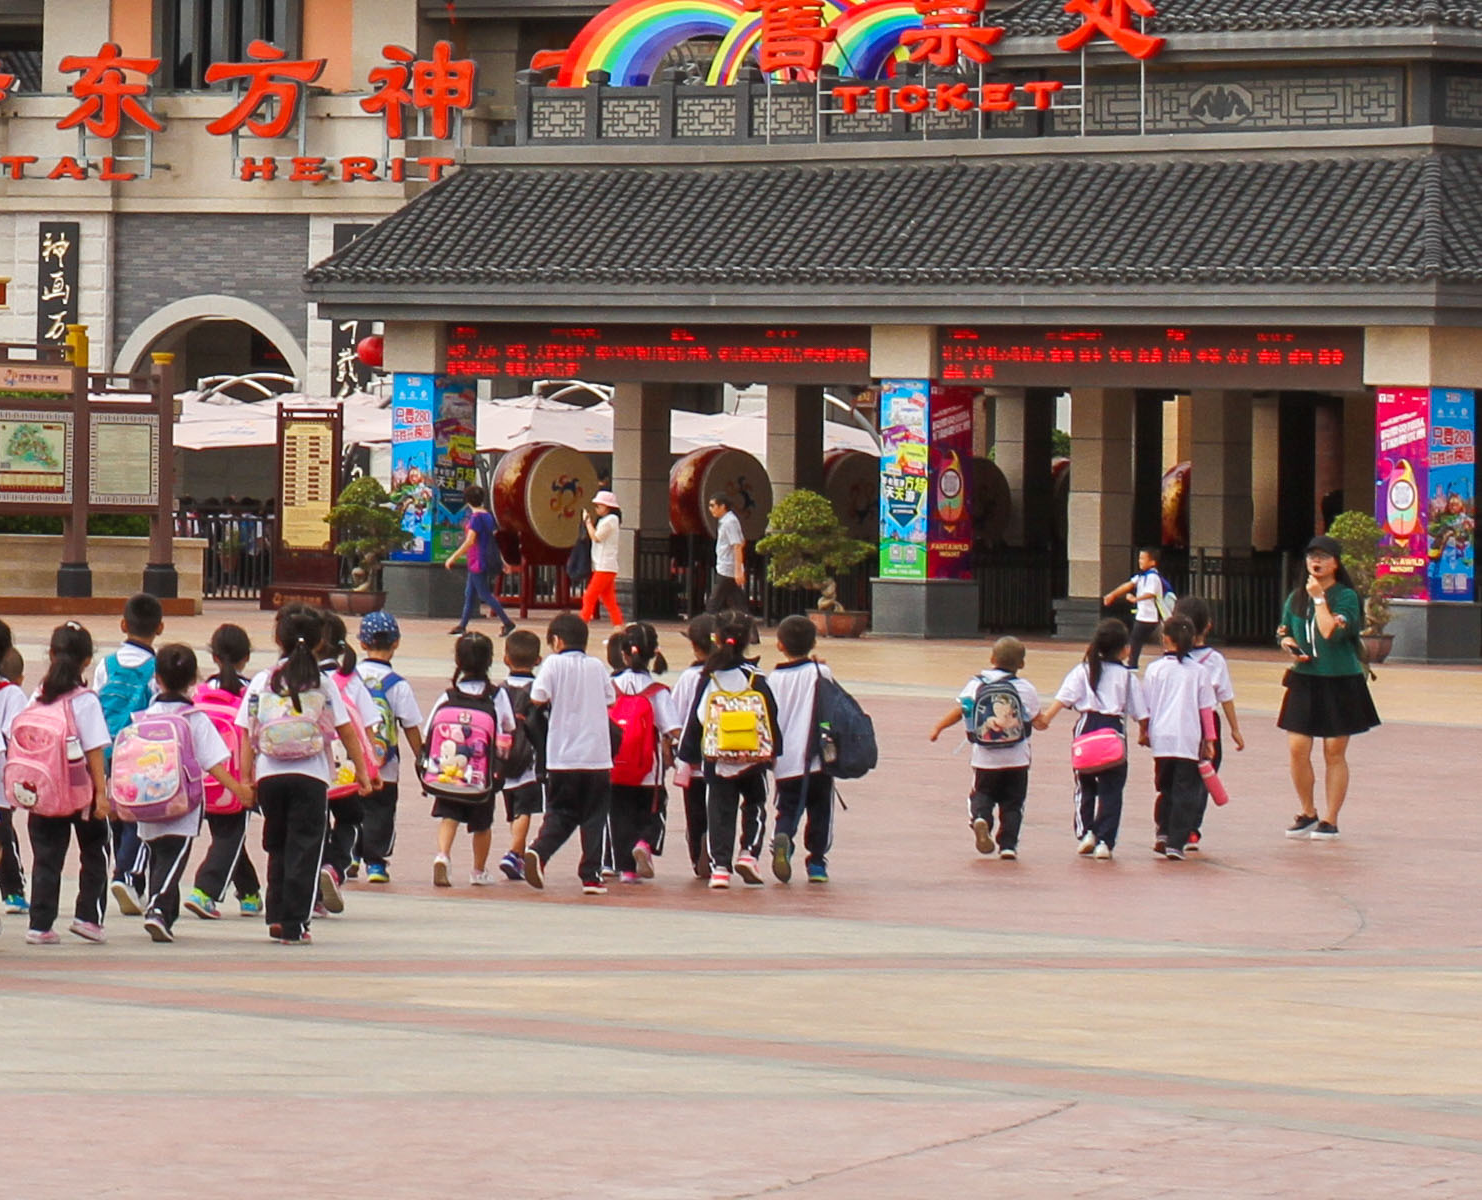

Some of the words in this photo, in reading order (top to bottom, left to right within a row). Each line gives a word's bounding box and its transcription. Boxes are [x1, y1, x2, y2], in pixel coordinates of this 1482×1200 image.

[831, 81, 1064, 114] TICKET
[240, 156, 456, 182] HERIT
[41, 231, 71, 345] 神画万
